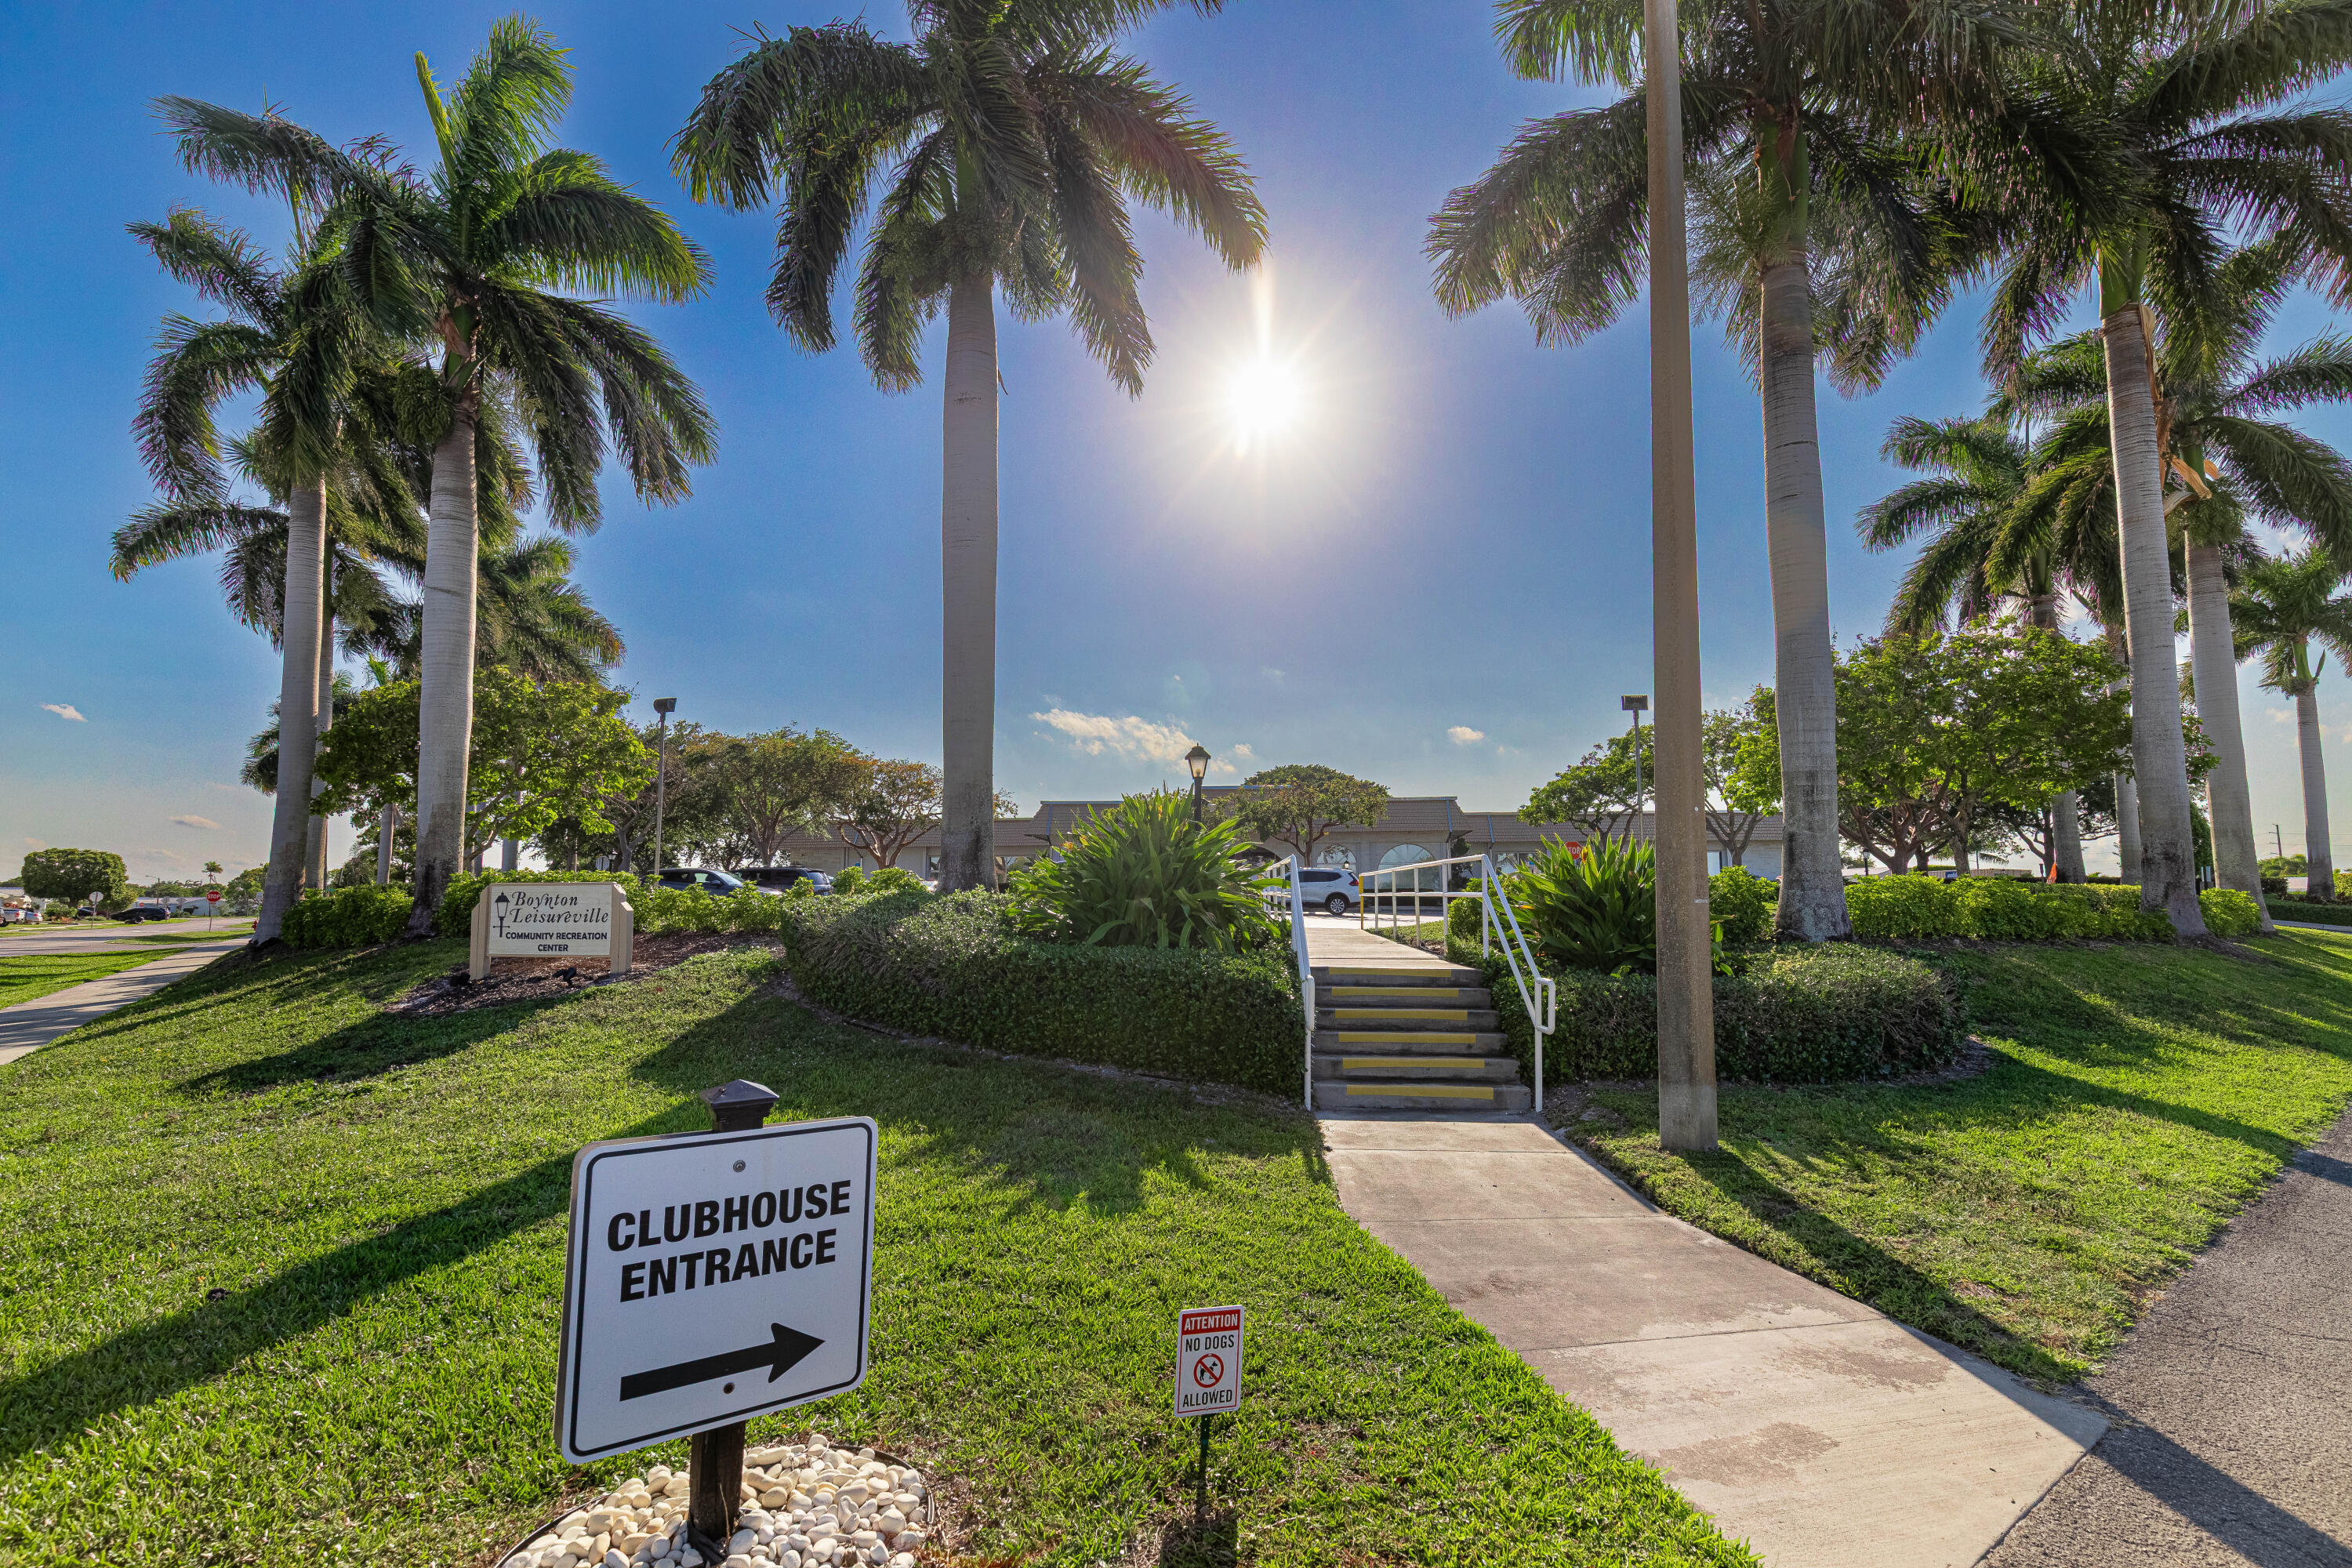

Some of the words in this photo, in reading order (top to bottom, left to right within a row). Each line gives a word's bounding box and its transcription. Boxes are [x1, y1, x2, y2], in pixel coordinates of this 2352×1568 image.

[511, 891, 578, 909] Boynton
[509, 908, 608, 924] Leisureville
[506, 931, 554, 940] COMMUNITY
[556, 931, 608, 940] RECREATION
[607, 1179, 851, 1252] CLUBHOUSE
[619, 1228, 837, 1303] ENTRANCE
[1184, 1314, 1238, 1330] ATTENTION
[1185, 1338, 1200, 1352] NO
[1204, 1334, 1235, 1350] DOGS
[1182, 1389, 1232, 1407] ALLOWED
